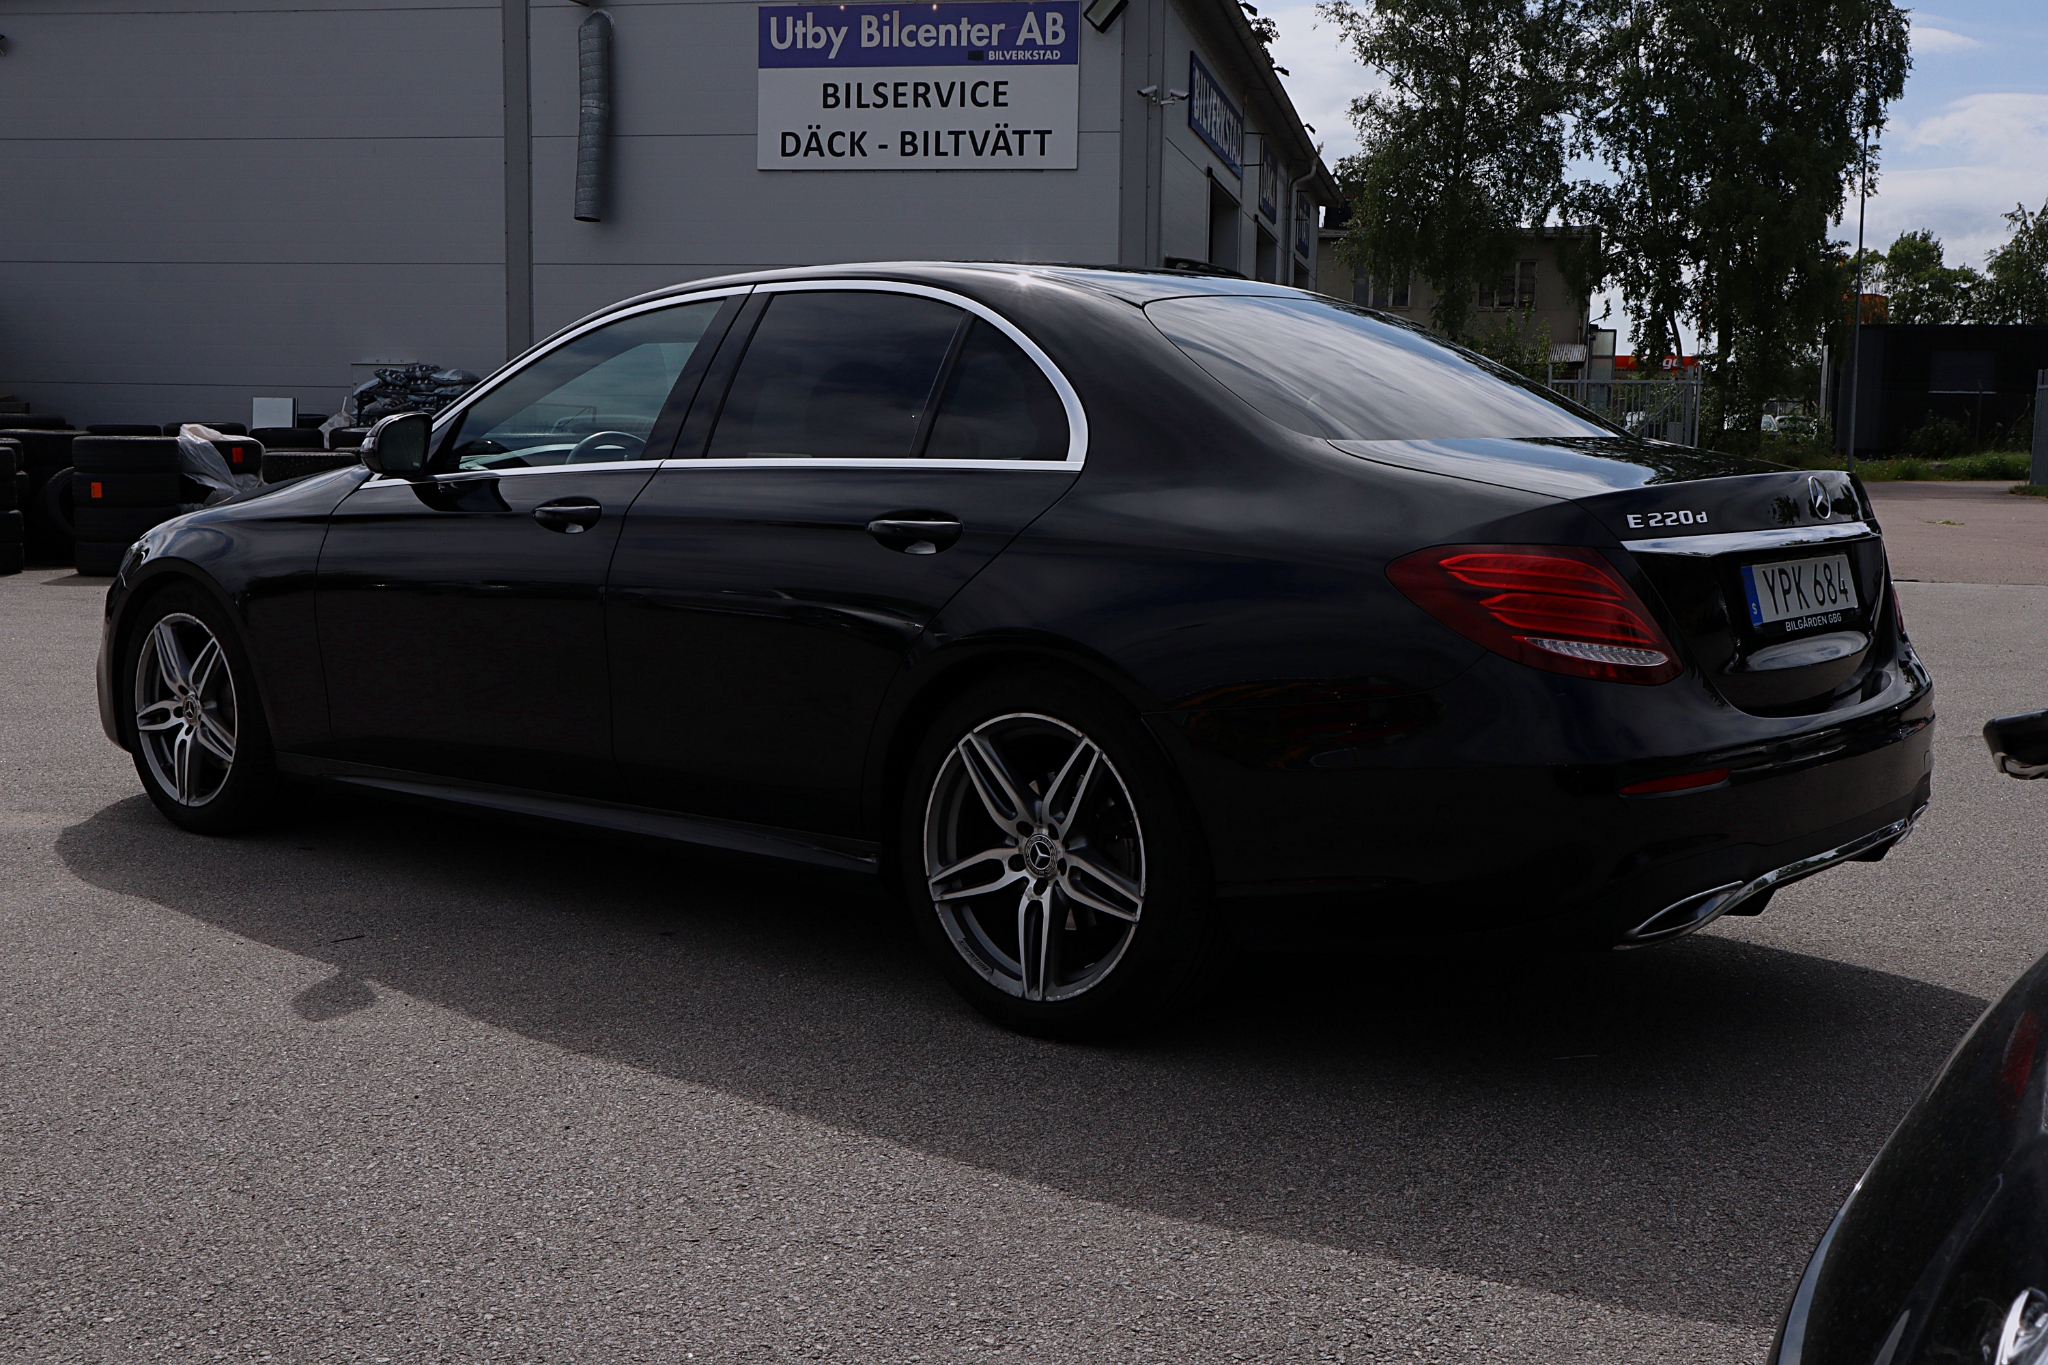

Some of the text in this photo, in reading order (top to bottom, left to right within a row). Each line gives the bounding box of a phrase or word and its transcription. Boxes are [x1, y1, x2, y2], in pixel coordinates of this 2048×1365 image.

[770, 10, 1066, 59] Utby Bilcenter AB
[988, 50, 1061, 61] BILVERKSTAD
[822, 80, 1009, 109] BILSERVICE
[1193, 65, 1242, 166] BILVERKSTAD
[780, 124, 868, 158] DÄCK
[900, 123, 1052, 157] BILTVÄTT
[1626, 514, 1645, 529] E
[1762, 561, 1849, 615] YPK 684
[1752, 602, 1758, 615] S
[1785, 612, 1842, 632] BILGÅRDEN GBG
